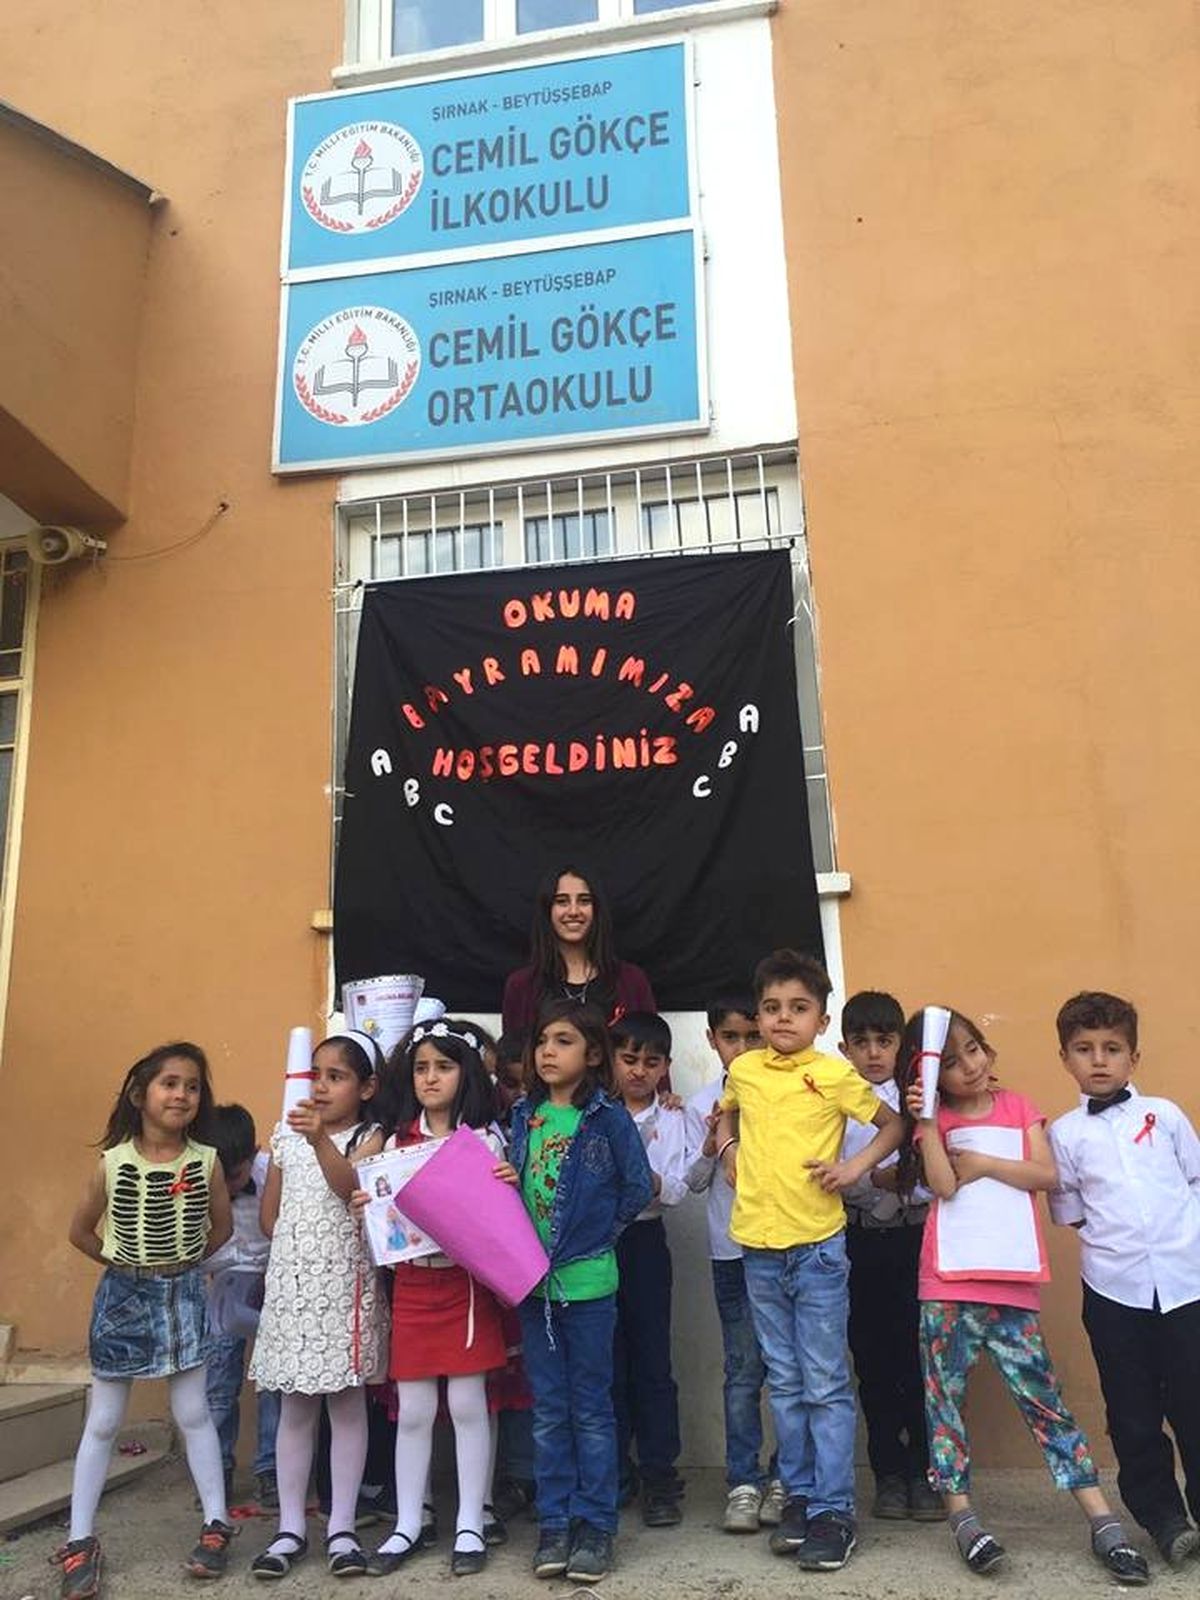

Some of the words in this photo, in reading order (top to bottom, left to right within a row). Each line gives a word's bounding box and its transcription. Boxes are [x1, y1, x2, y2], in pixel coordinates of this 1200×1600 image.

[431, 125, 539, 177] CEMİL
[549, 112, 670, 156] GÖKÇE
[430, 174, 610, 232] İLKOKULU
[428, 314, 540, 369] CEMİL
[551, 302, 677, 349] GÖKÇE
[427, 364, 653, 427] ORTAOKULU
[502, 587, 636, 629] OKUMA
[737, 703, 761, 734] A
[717, 739, 738, 770] B
[370, 748, 394, 777] A
[402, 777, 421, 808] B
[433, 802, 455, 827] C
[692, 774, 712, 799] C
